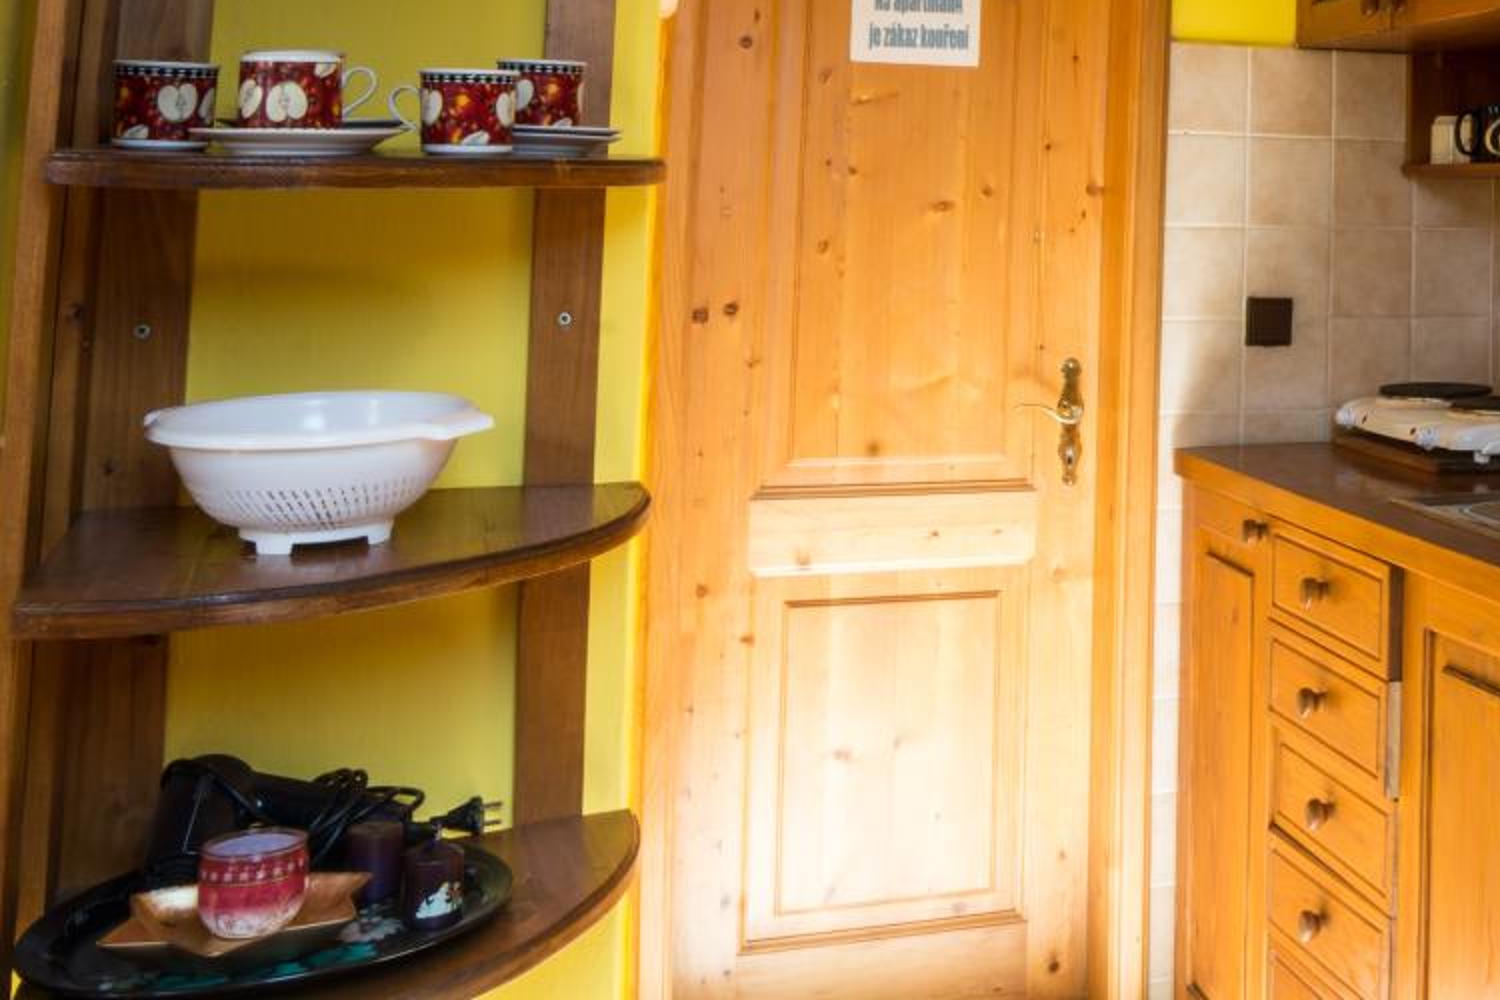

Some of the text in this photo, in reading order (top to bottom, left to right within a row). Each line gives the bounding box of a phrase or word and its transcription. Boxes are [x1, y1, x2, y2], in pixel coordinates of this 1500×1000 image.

[869, 22, 969, 50] je zákaz kouření
